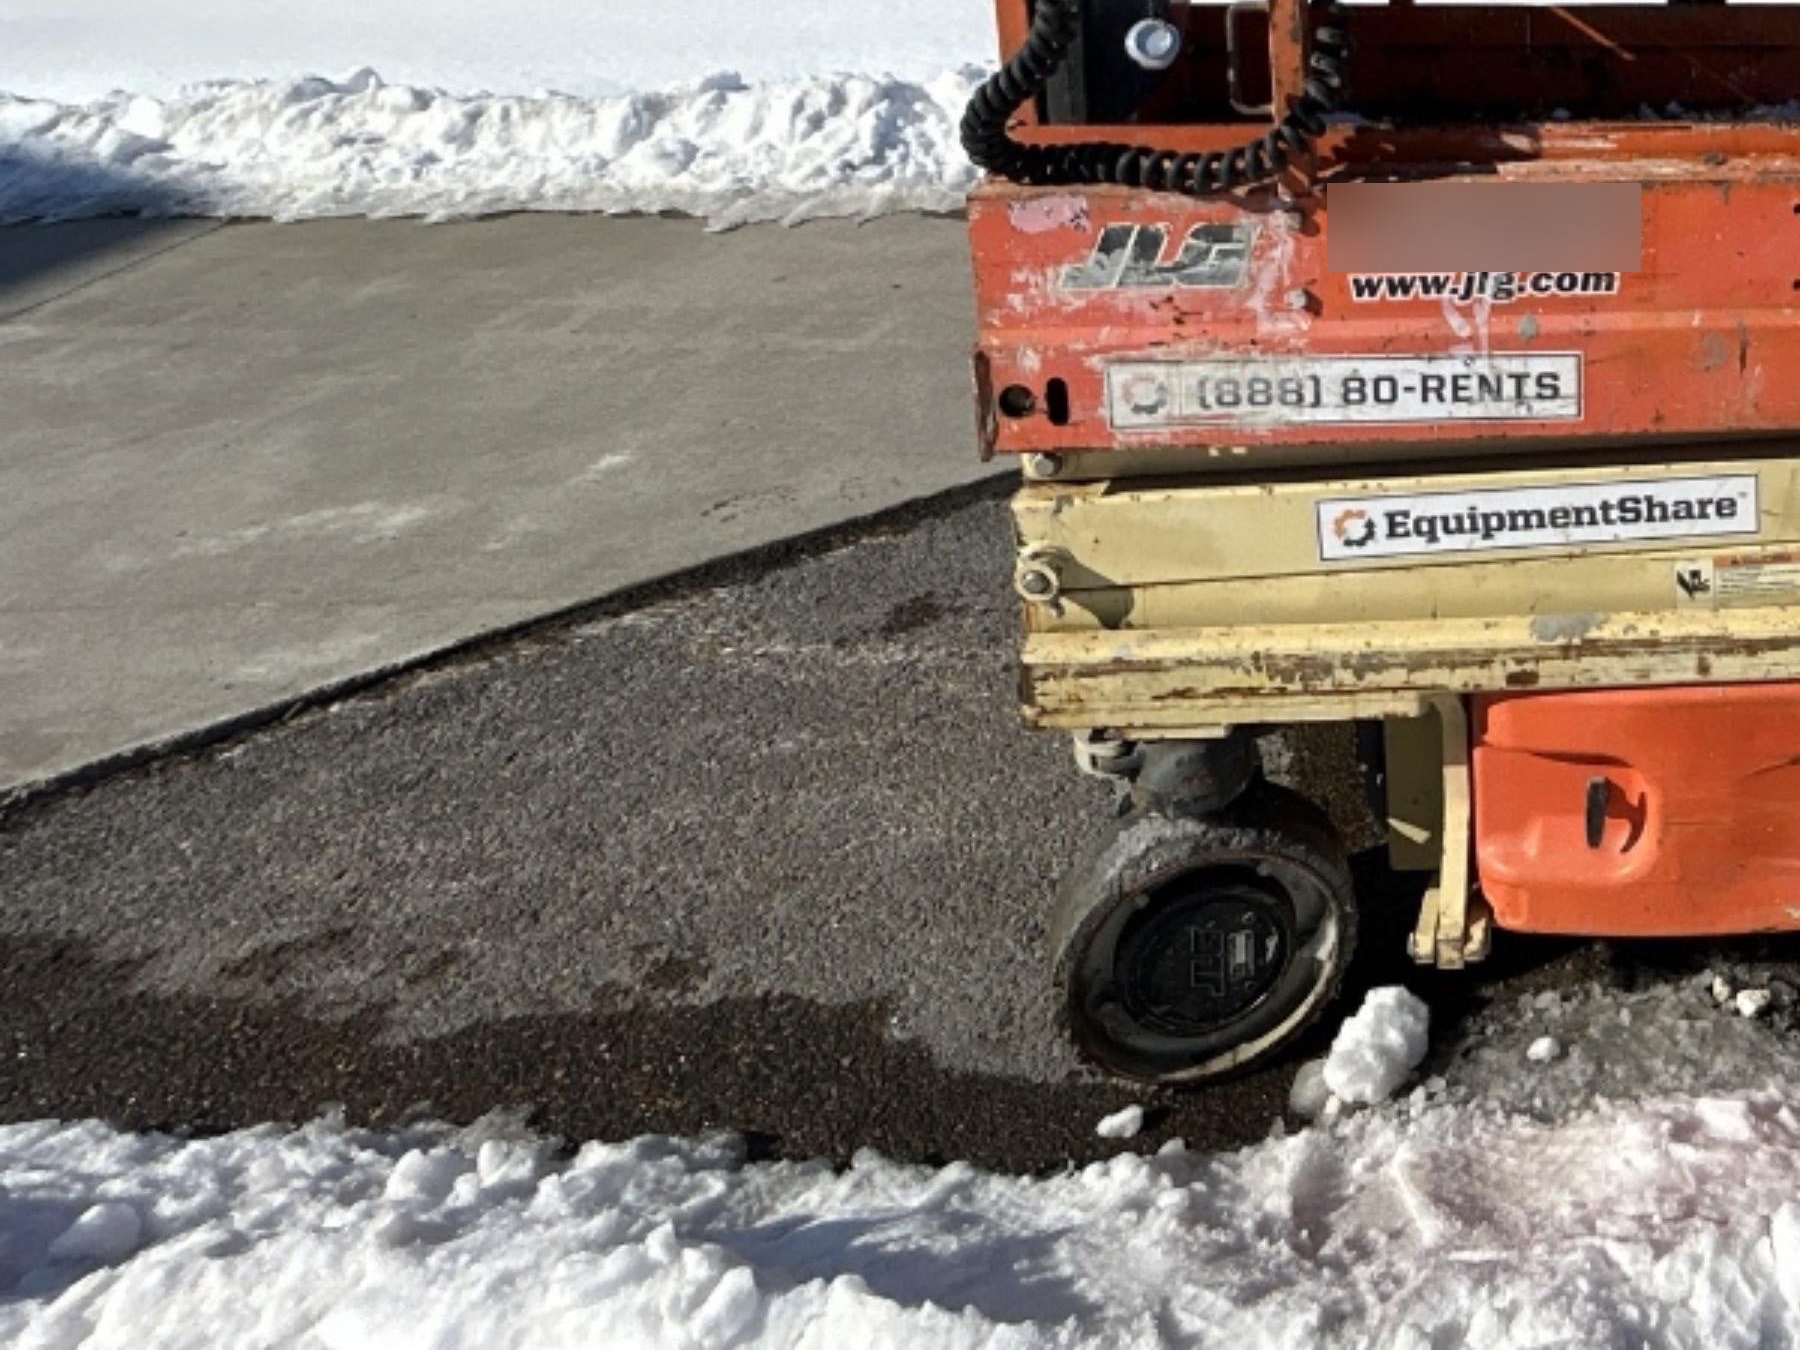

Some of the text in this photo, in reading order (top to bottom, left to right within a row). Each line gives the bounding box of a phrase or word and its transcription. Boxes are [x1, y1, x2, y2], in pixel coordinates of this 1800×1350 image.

[1057, 221, 1259, 291] JLG
[1198, 371, 1562, 410] (888) 80-RENTS
[1384, 493, 1739, 543] EquipmentShare
